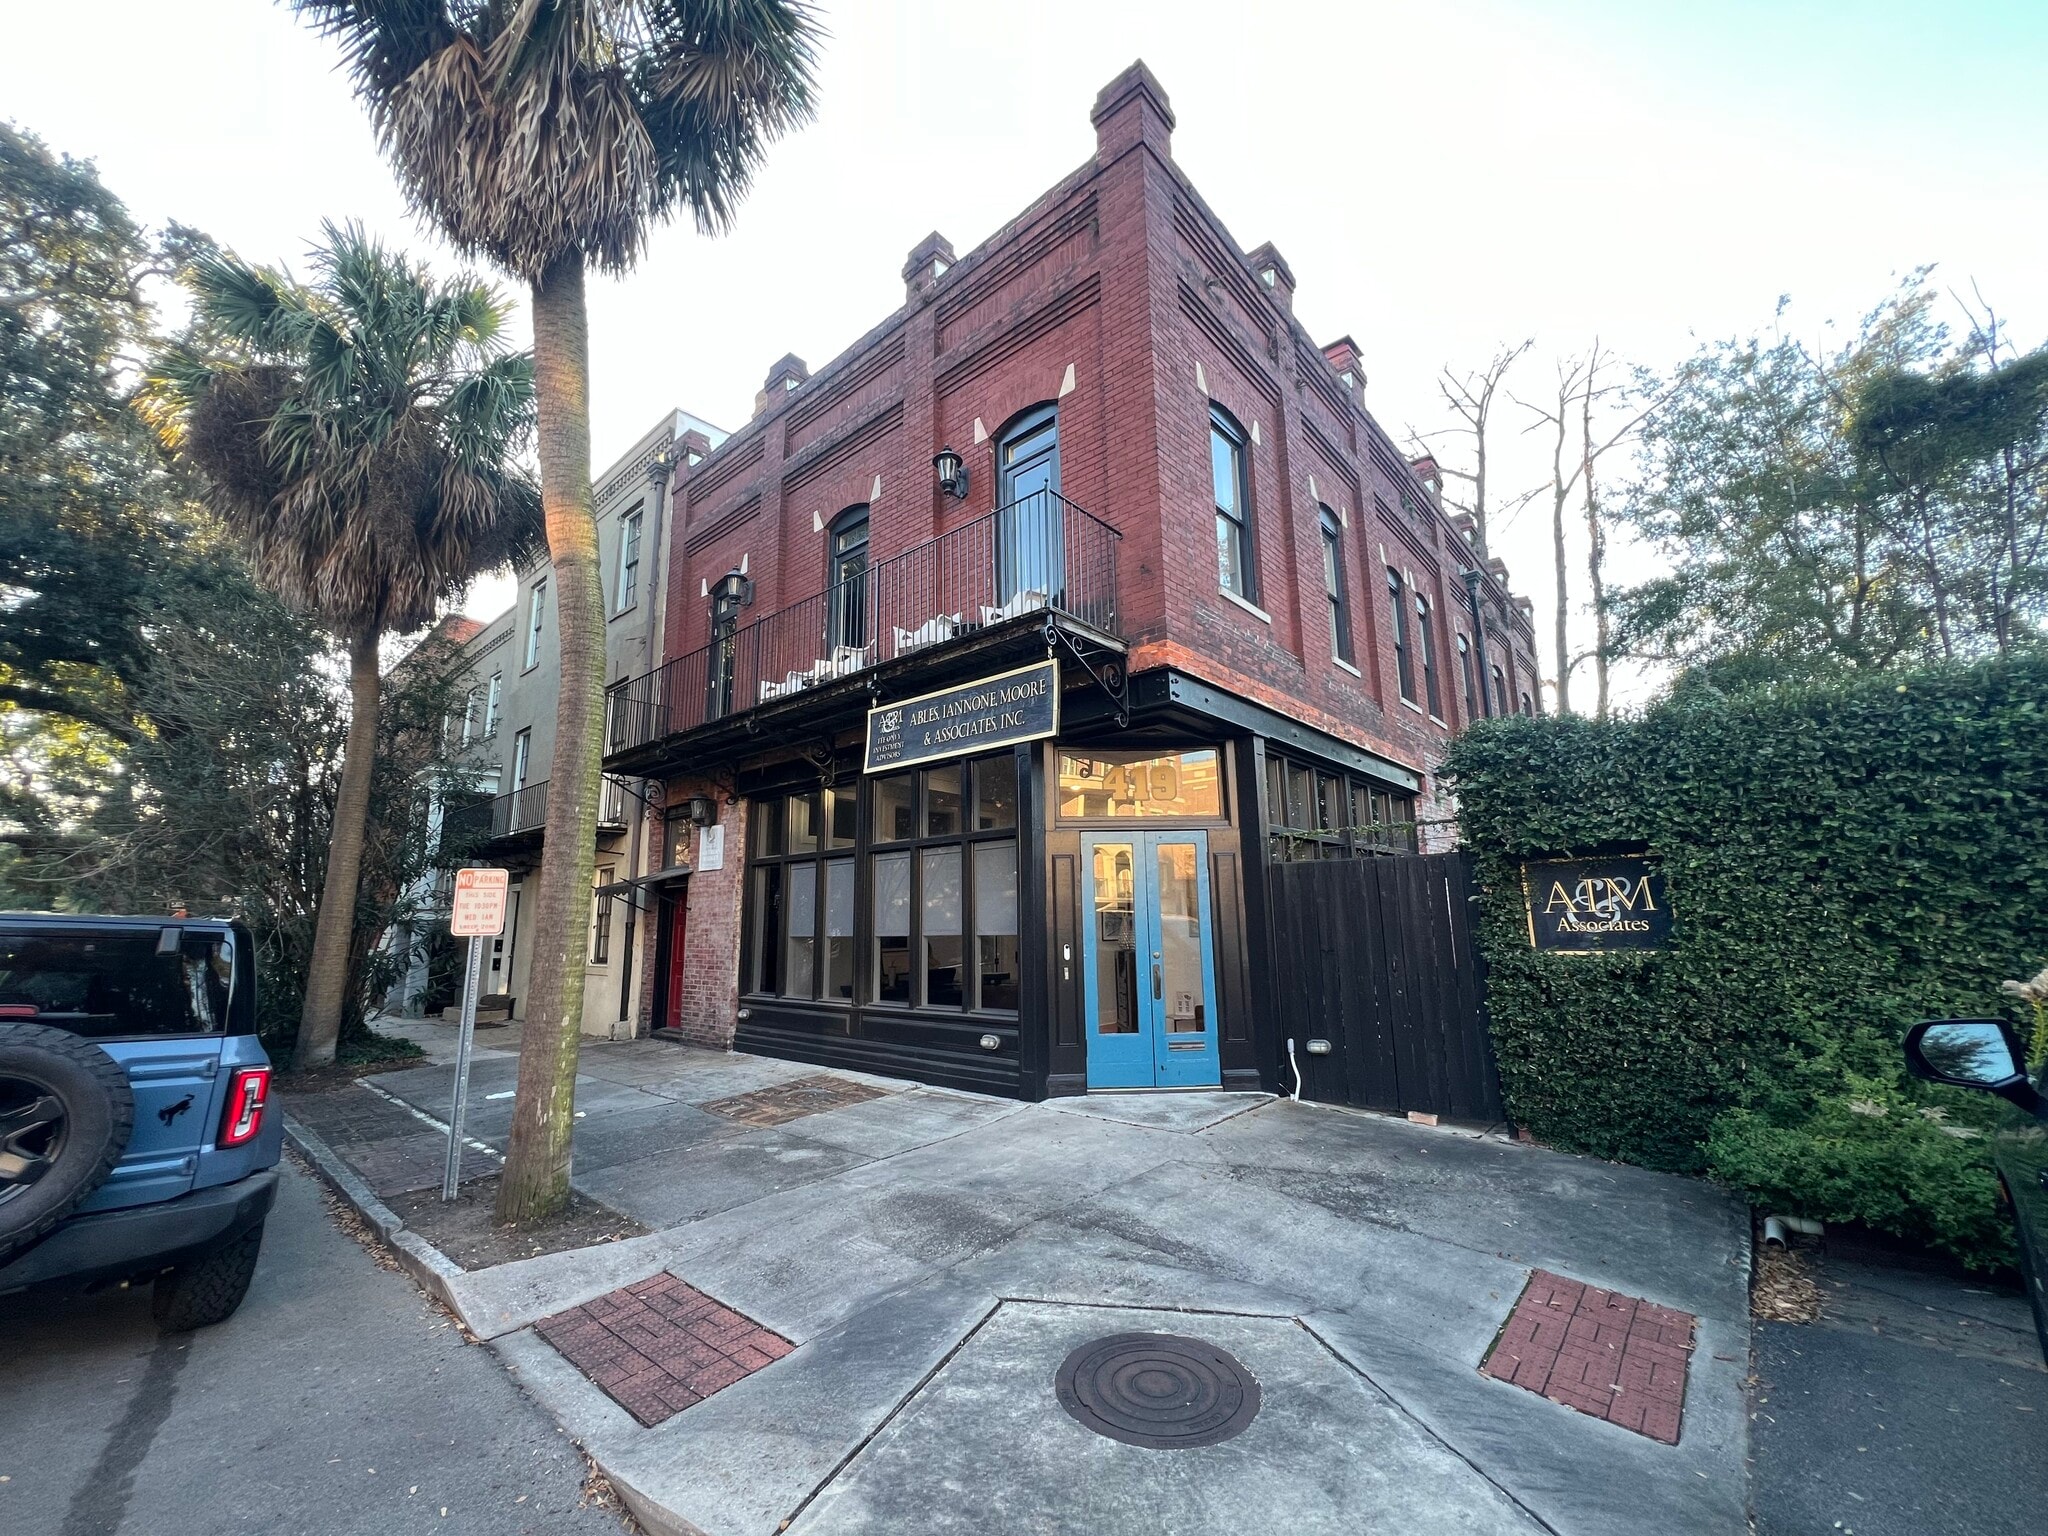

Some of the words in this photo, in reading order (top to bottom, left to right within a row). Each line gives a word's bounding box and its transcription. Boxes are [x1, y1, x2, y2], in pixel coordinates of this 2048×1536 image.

[1000, 678, 1047, 705] MOORE
[923, 731, 931, 746] &
[1000, 709, 1026, 729] INC.
[872, 740, 905, 754] INVESTMENT
[875, 751, 901, 763] ADVISORS
[1102, 764, 1178, 801] 419
[459, 873, 473, 887] NO
[475, 874, 505, 884] PARKING
[1556, 916, 1650, 933] Associates
